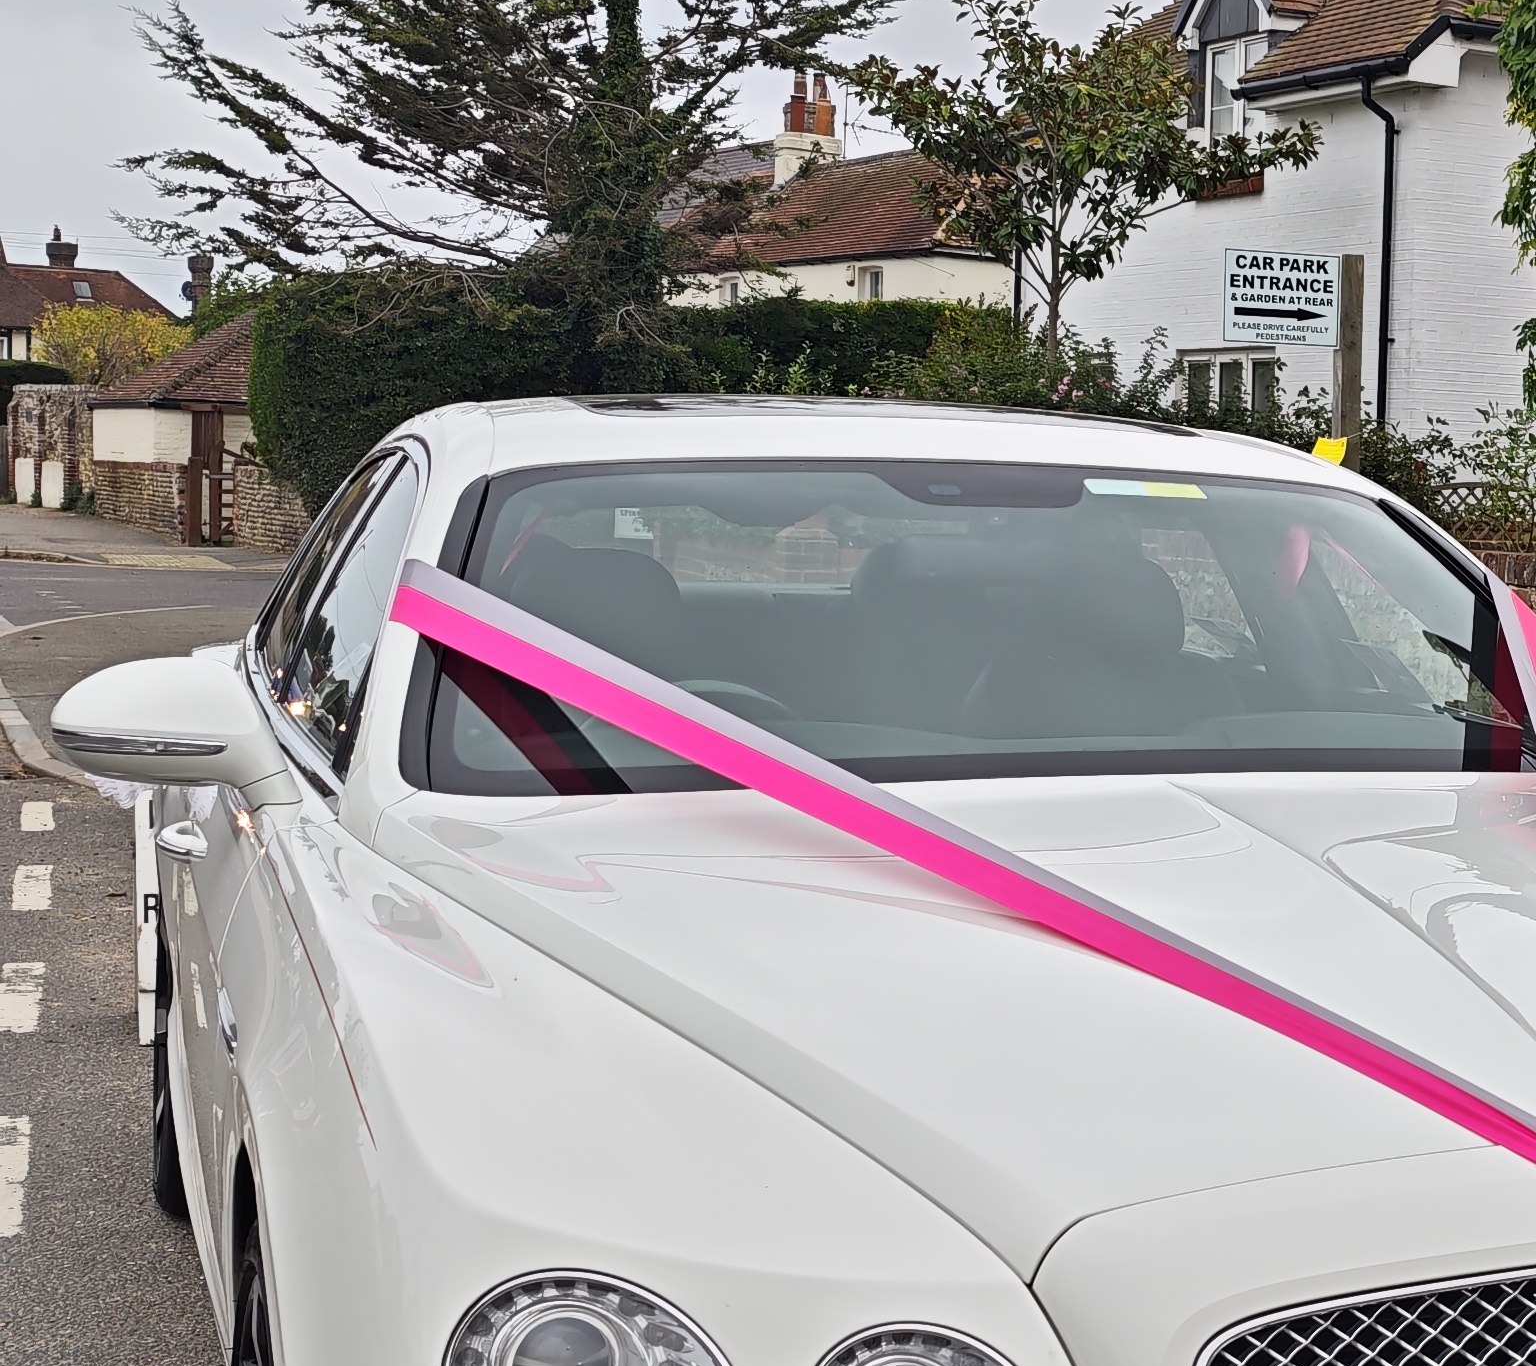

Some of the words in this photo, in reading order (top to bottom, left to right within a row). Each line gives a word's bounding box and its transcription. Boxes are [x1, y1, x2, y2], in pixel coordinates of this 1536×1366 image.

[1235, 254, 1275, 271] CAR
[1279, 257, 1329, 275] PARK
[1229, 273, 1334, 294] ENTRANCE
[1231, 293, 1238, 302] &
[1241, 293, 1286, 305] GARDEN
[1288, 296, 1303, 305] AT
[1304, 297, 1333, 307] REAR
[1232, 321, 1262, 331] PLEASE
[1263, 323, 1285, 332] DRIVE
[1286, 324, 1329, 334] CAREFULLY
[1255, 332, 1307, 342] PEDESTRIANS
